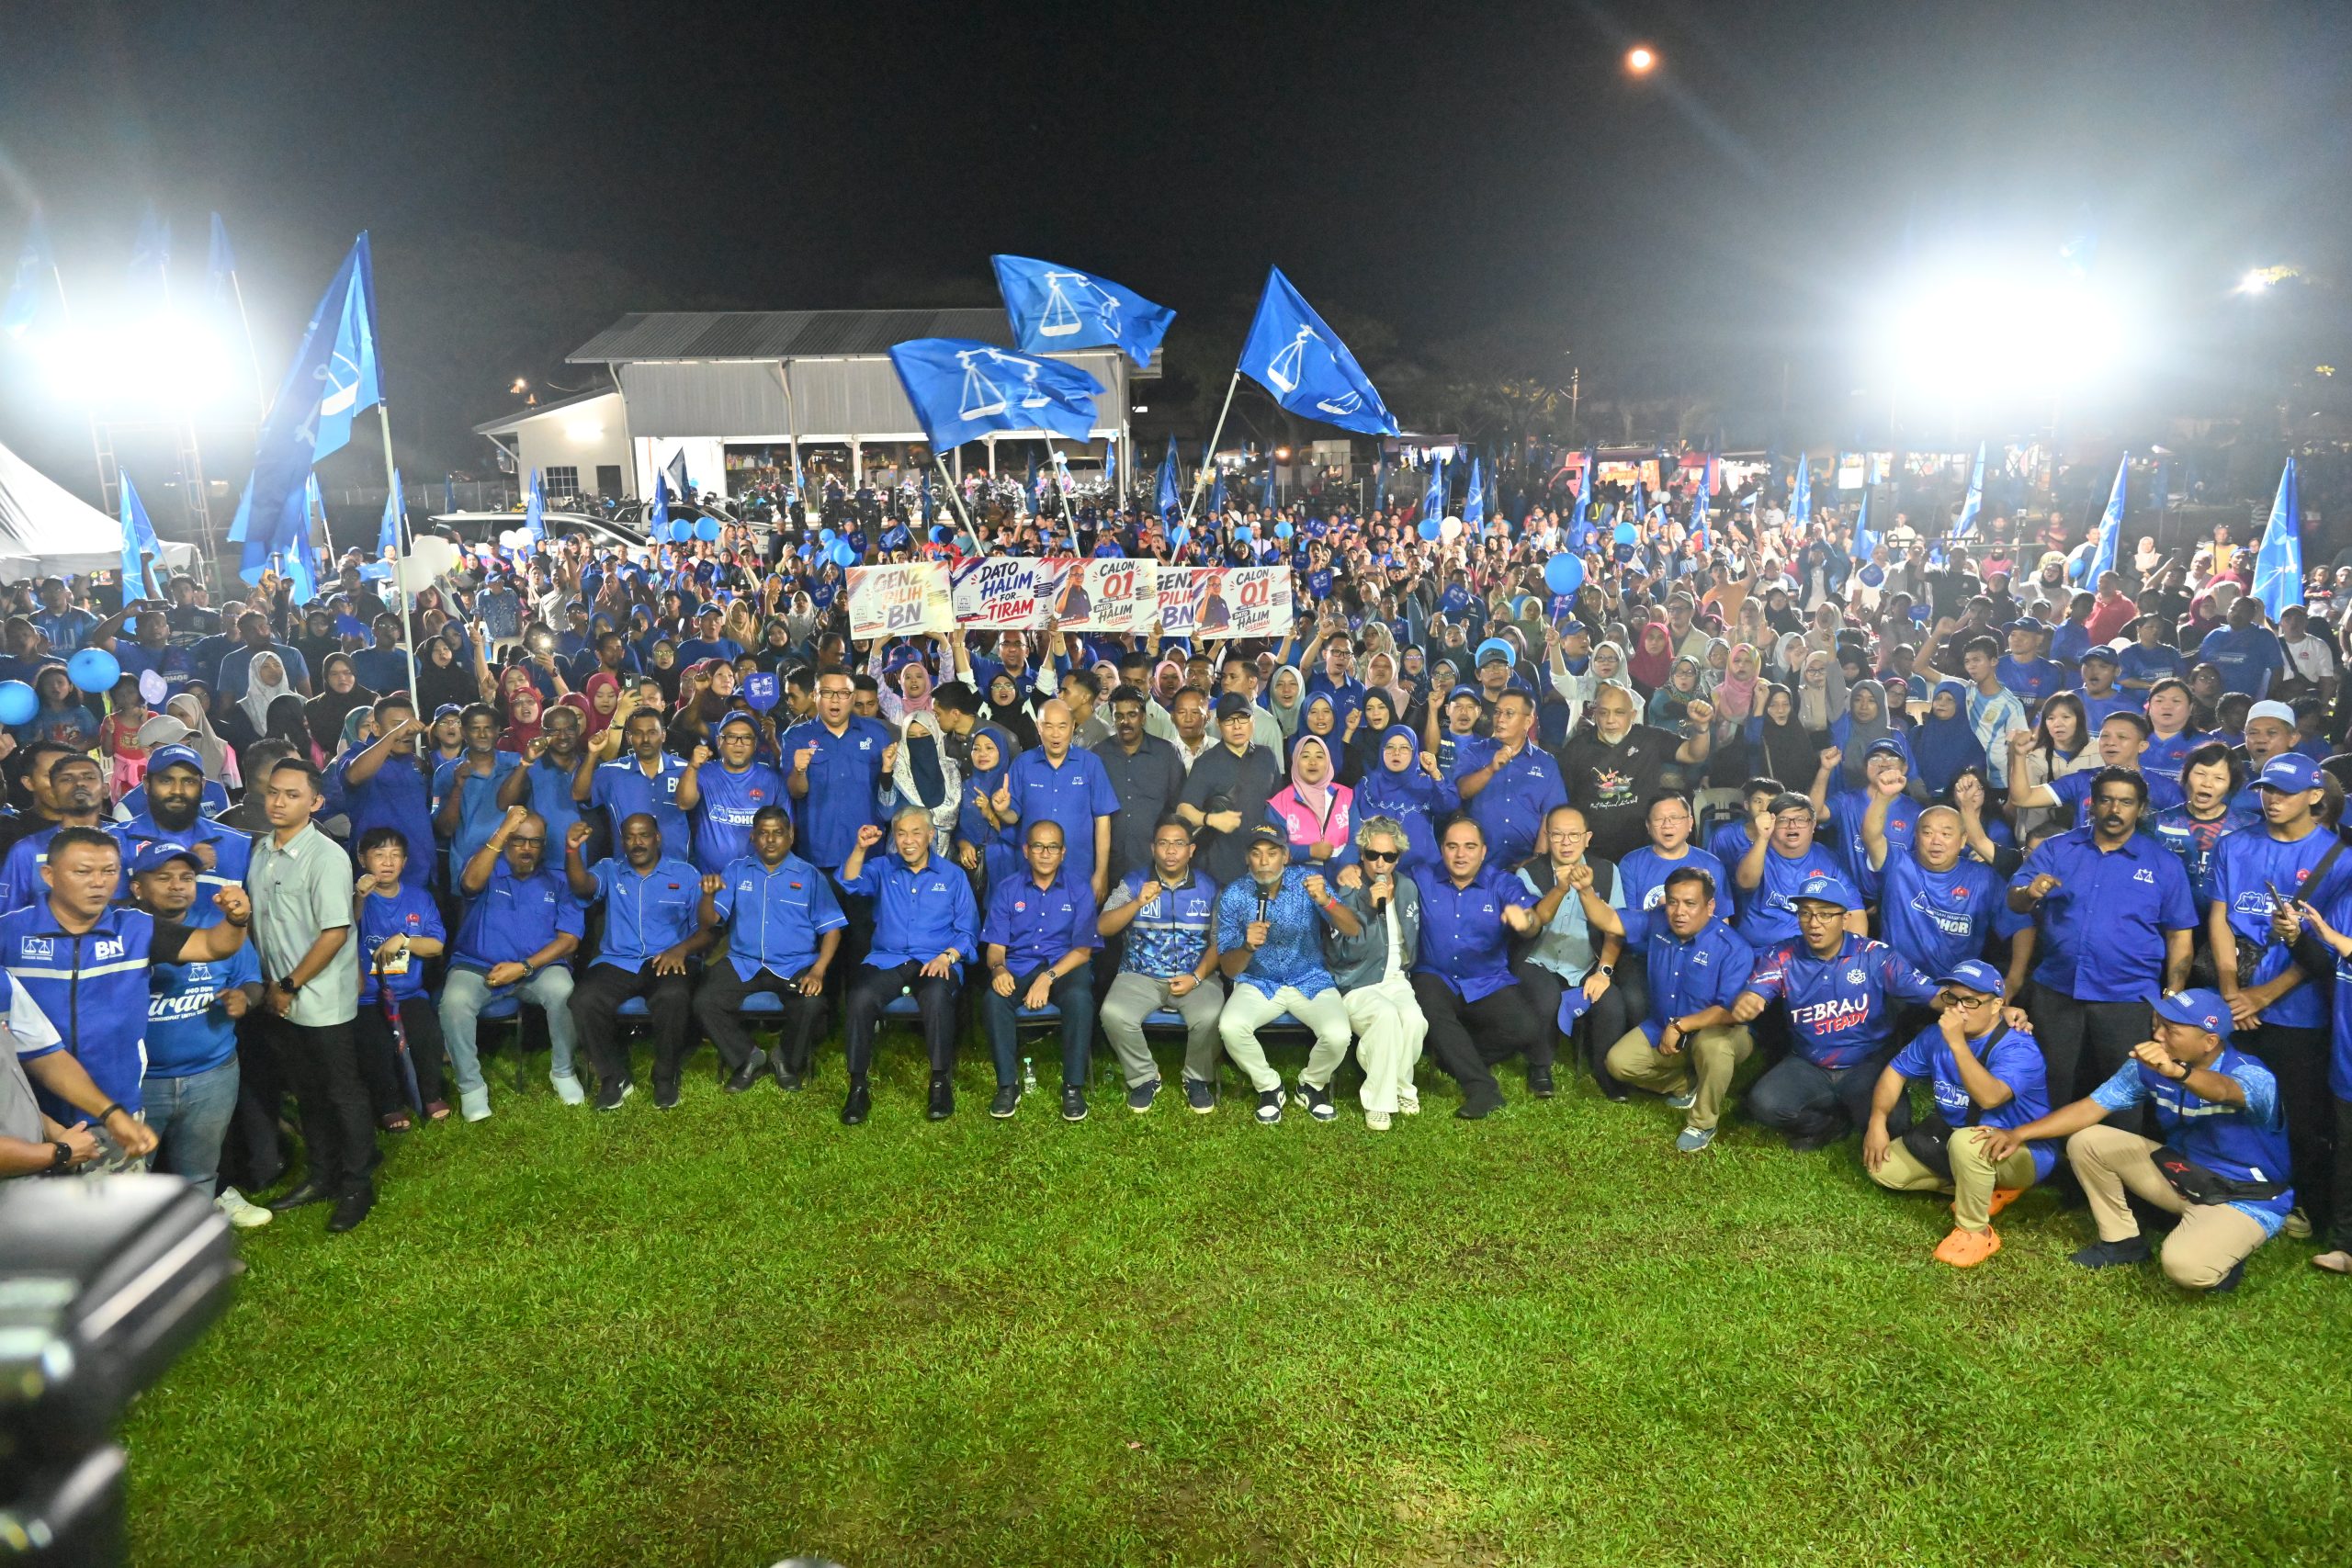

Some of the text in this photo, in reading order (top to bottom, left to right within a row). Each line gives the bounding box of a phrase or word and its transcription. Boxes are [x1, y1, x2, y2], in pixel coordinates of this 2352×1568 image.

[979, 561, 1019, 583] DATO
[1100, 561, 1135, 577] CALON
[1236, 569, 1269, 586] CALON
[883, 585, 922, 605] PILIH
[980, 570, 1034, 601] HALIM
[1103, 570, 1135, 598] 01
[1240, 578, 1268, 605] 01
[1000, 592, 1016, 602] FOR
[888, 601, 922, 628] BN
[988, 598, 1035, 620] TIRAM
[1098, 604, 1133, 624] HALIM
[1162, 606, 1193, 628] BN
[1235, 610, 1248, 618] DATO
[1237, 610, 1270, 630] HALIM
[1807, 884, 1822, 892] BN
[1407, 901, 1419, 918] WTA
[96, 936, 124, 958] BN
[1791, 993, 1868, 1023] TEBRAU
[1815, 1009, 1869, 1035] STEADY
